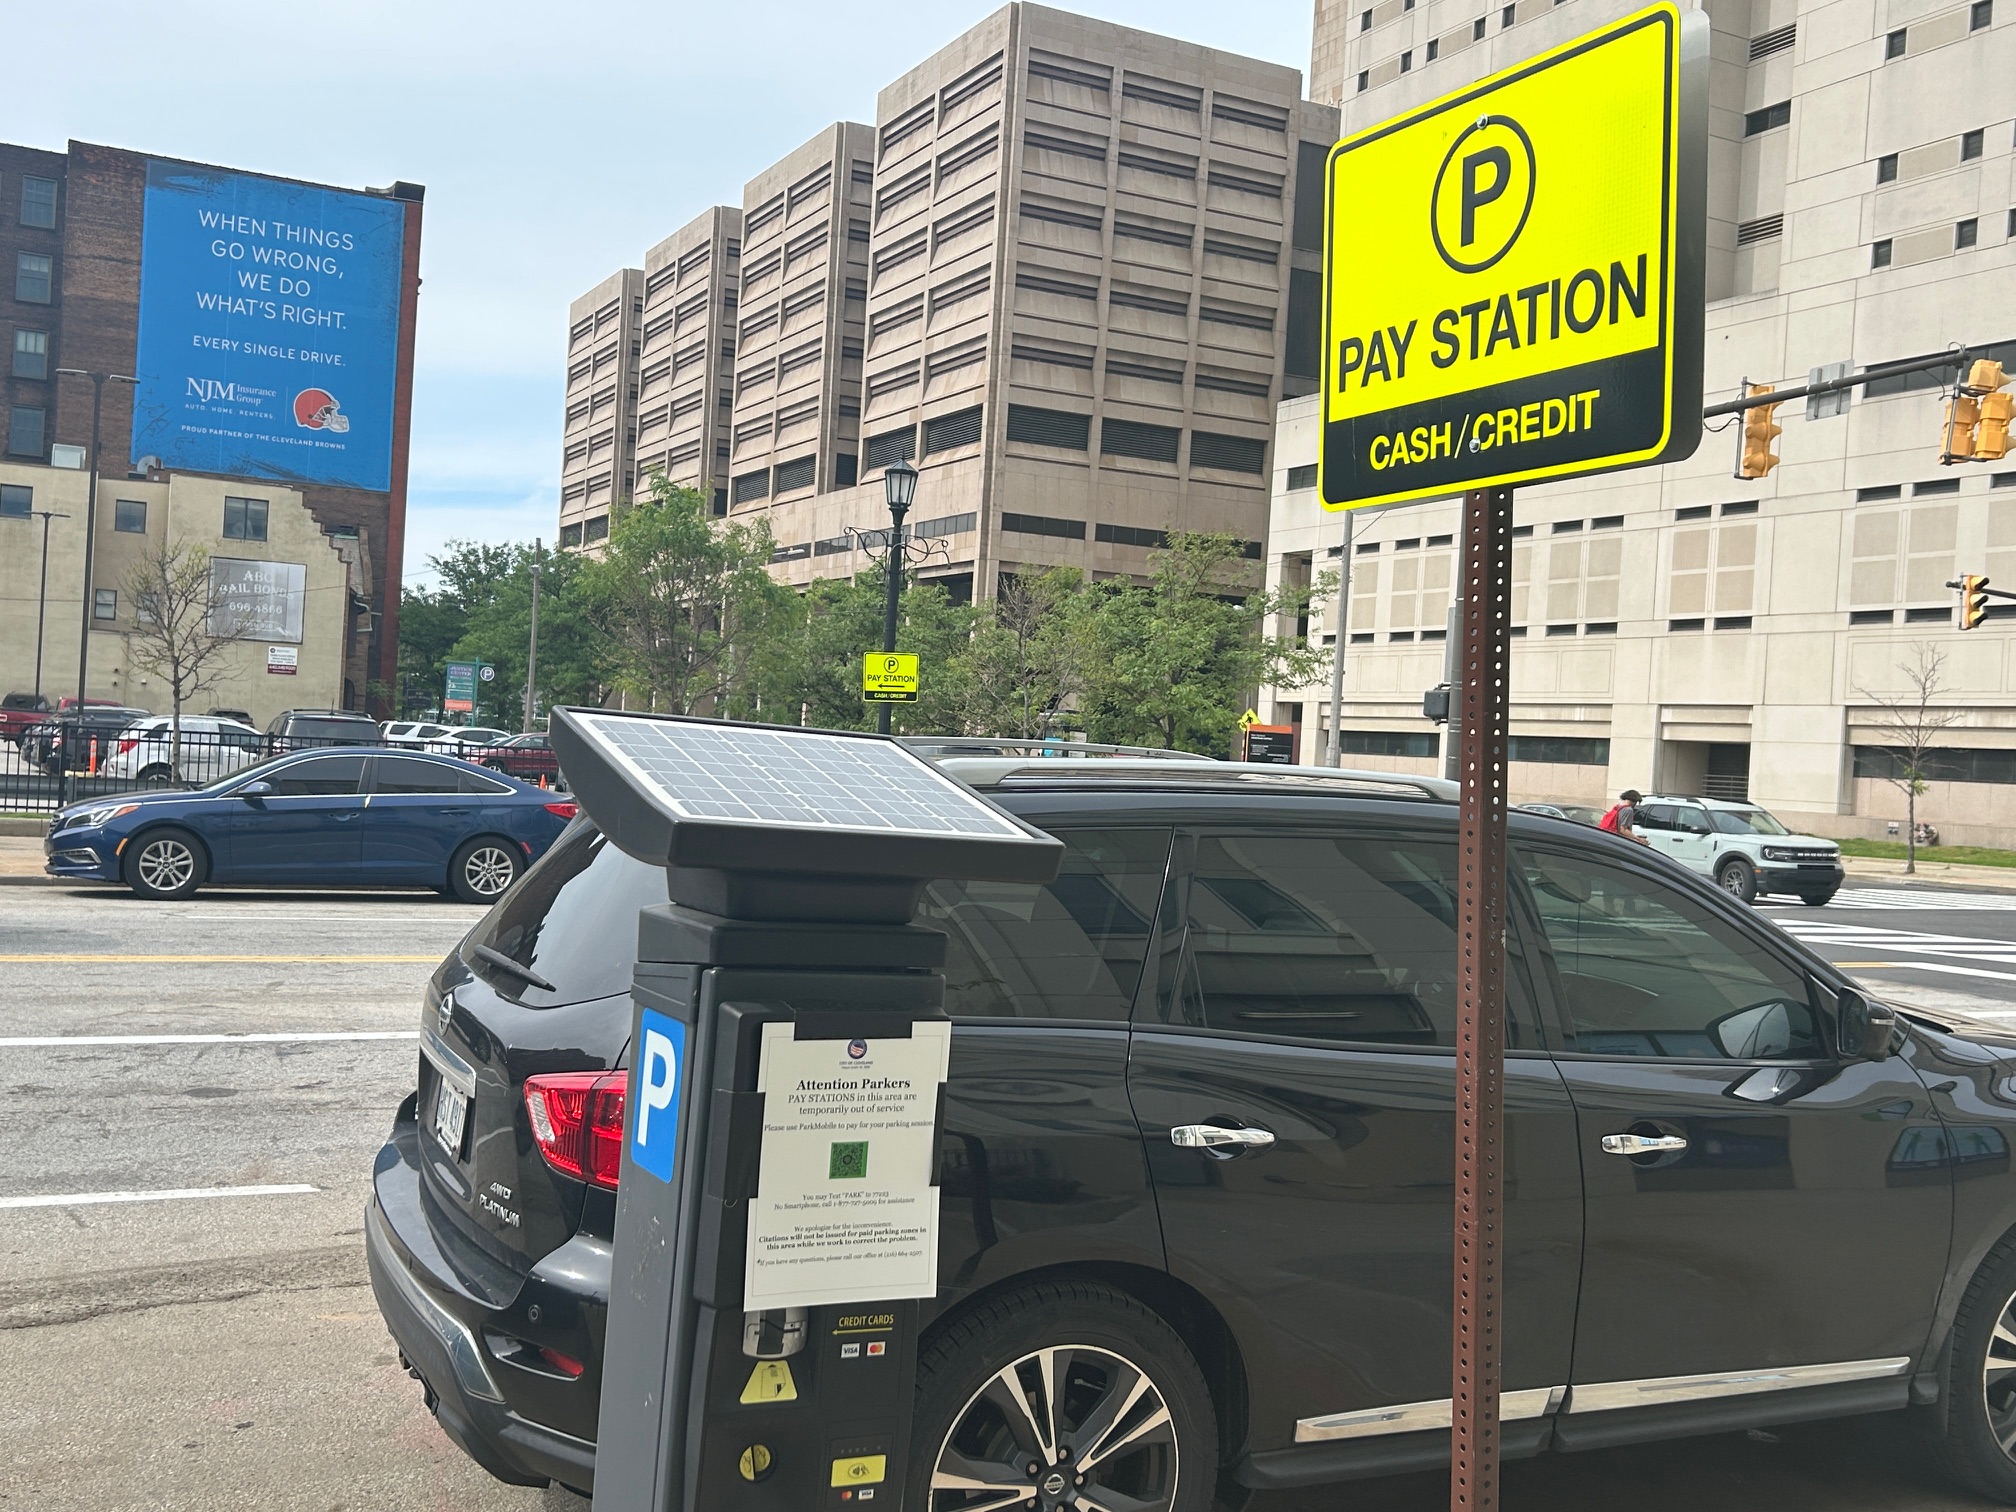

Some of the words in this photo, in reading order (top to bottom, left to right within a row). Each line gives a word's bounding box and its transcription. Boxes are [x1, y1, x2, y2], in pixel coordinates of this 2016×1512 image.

[1461, 146, 1511, 247] P
[198, 209, 266, 237] WHEN
[272, 222, 354, 250] THINGS
[212, 240, 244, 260] GO
[252, 246, 344, 279] WRONG,
[238, 270, 272, 292] WE
[280, 277, 310, 297] DO
[196, 292, 276, 319] WHAT'S
[282, 304, 346, 330] RIGHT.
[1339, 319, 1417, 393] PAY
[1431, 253, 1647, 370] STATION
[193, 335, 239, 352] EVERY
[244, 342, 296, 360] SINGLE
[300, 350, 346, 366] DRIVE.
[186, 377, 236, 402] NJM
[237, 384, 276, 396] Insurance
[236, 394, 261, 406] Group
[182, 425, 207, 434] PROUD
[209, 428, 242, 438] PARTNER
[272, 436, 313, 446] CLEVELAND
[315, 442, 346, 450] BROWNS
[243, 570, 273, 582] ABC
[220, 583, 250, 594] BAIL
[888, 660, 896, 670] P
[884, 674, 915, 682] STATION
[637, 1028, 676, 1147] P
[796, 1078, 857, 1090] Attention
[862, 1078, 910, 1089] Parkers
[788, 1094, 806, 1103] PAY
[808, 1092, 855, 1102] STATIONS
[857, 1093, 865, 1101] in
[868, 1092, 882, 1101] this
[800, 1104, 849, 1116] temporarily
[866, 1104, 876, 1113] of
[877, 1104, 904, 1112] service
[799, 1122, 836, 1130] ParkMobile
[846, 1122, 858, 1130] pay
[870, 1122, 884, 1130] your
[886, 1120, 910, 1129] parking
[490, 1182, 511, 1200] 4WD
[480, 1193, 520, 1228] PLATINUM
[759, 1234, 789, 1243] Citations
[858, 1229, 873, 1237] paid
[874, 1228, 899, 1236] parking
[805, 1224, 831, 1233] apologize
[888, 1235, 918, 1244] problem.
[839, 1316, 866, 1327] CREDIT
[868, 1314, 894, 1325] CARDS
